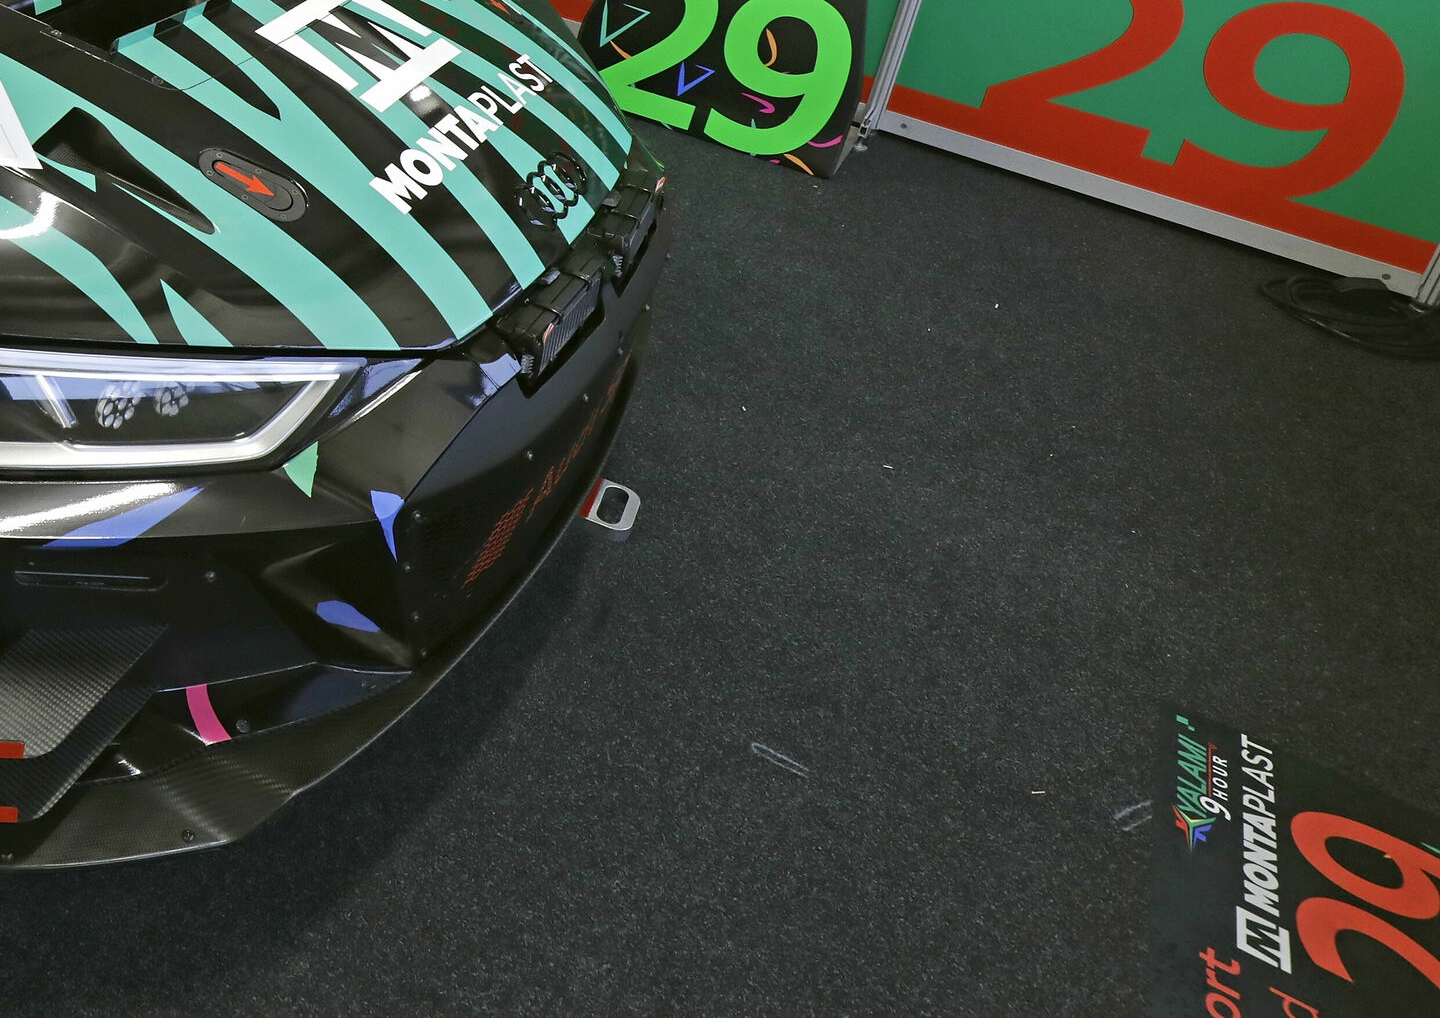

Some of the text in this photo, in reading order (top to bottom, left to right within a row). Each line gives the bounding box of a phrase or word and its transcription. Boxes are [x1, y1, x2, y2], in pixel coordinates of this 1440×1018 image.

[368, 53, 553, 215] MONTAPLAST
[1172, 733, 1213, 848] KYALAMI
[1200, 755, 1232, 821] 9 HOUR
[1241, 734, 1280, 918] MONTAPLAST
